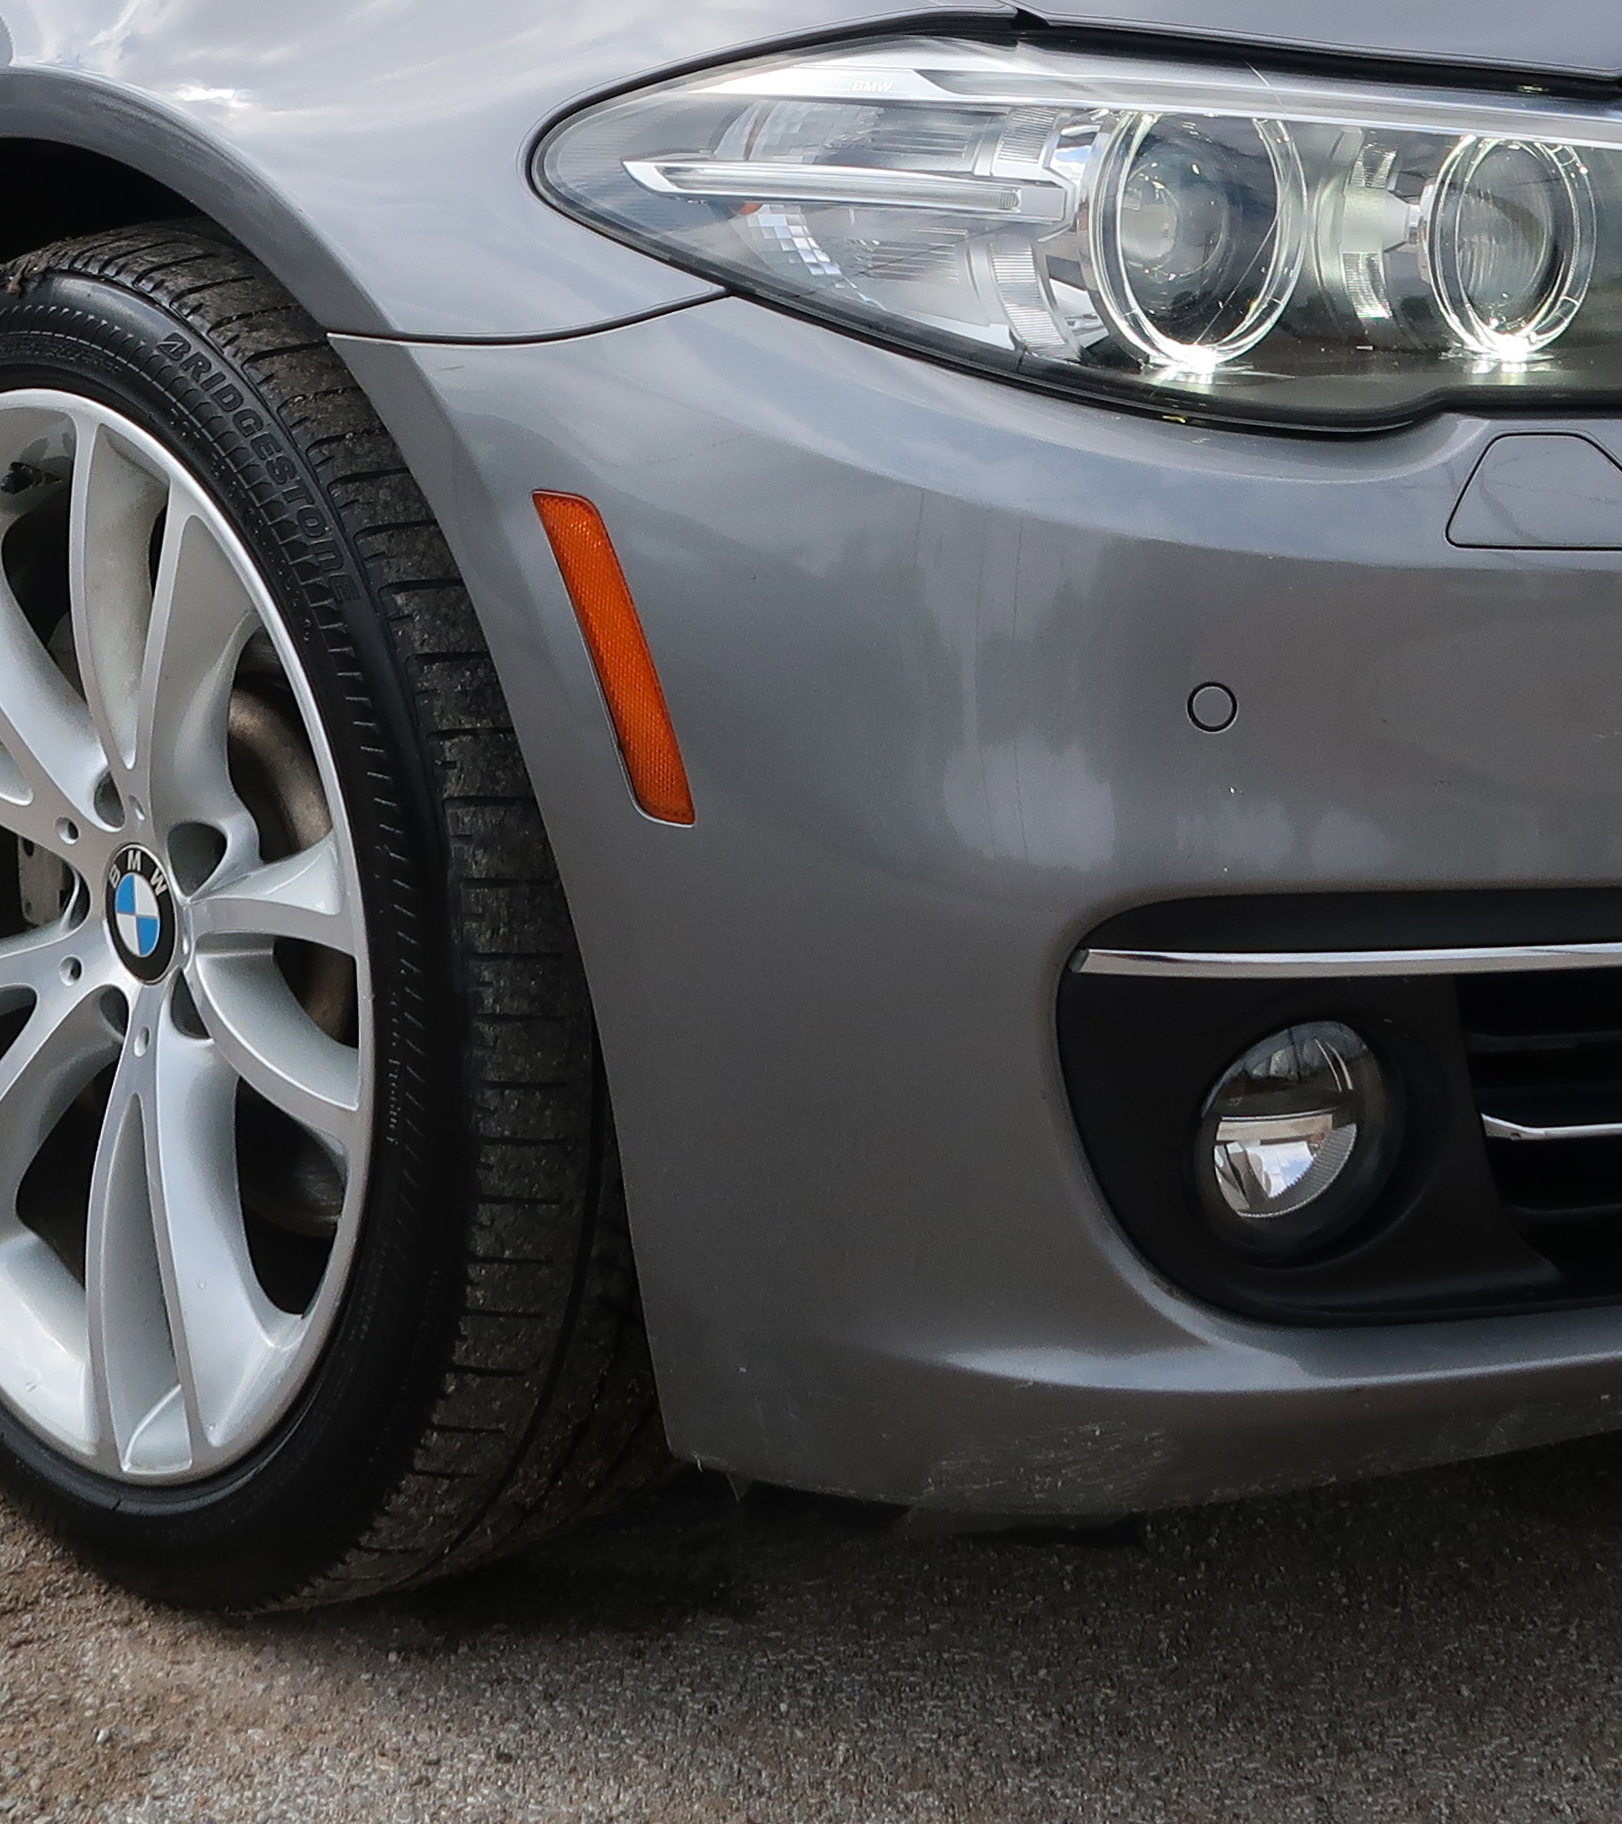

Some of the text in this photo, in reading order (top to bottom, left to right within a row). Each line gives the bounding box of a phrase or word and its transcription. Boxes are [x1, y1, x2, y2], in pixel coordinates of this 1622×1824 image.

[851, 79, 894, 93] BMW
[155, 330, 360, 606] BRIDGESTONE
[108, 849, 169, 897] BMW
